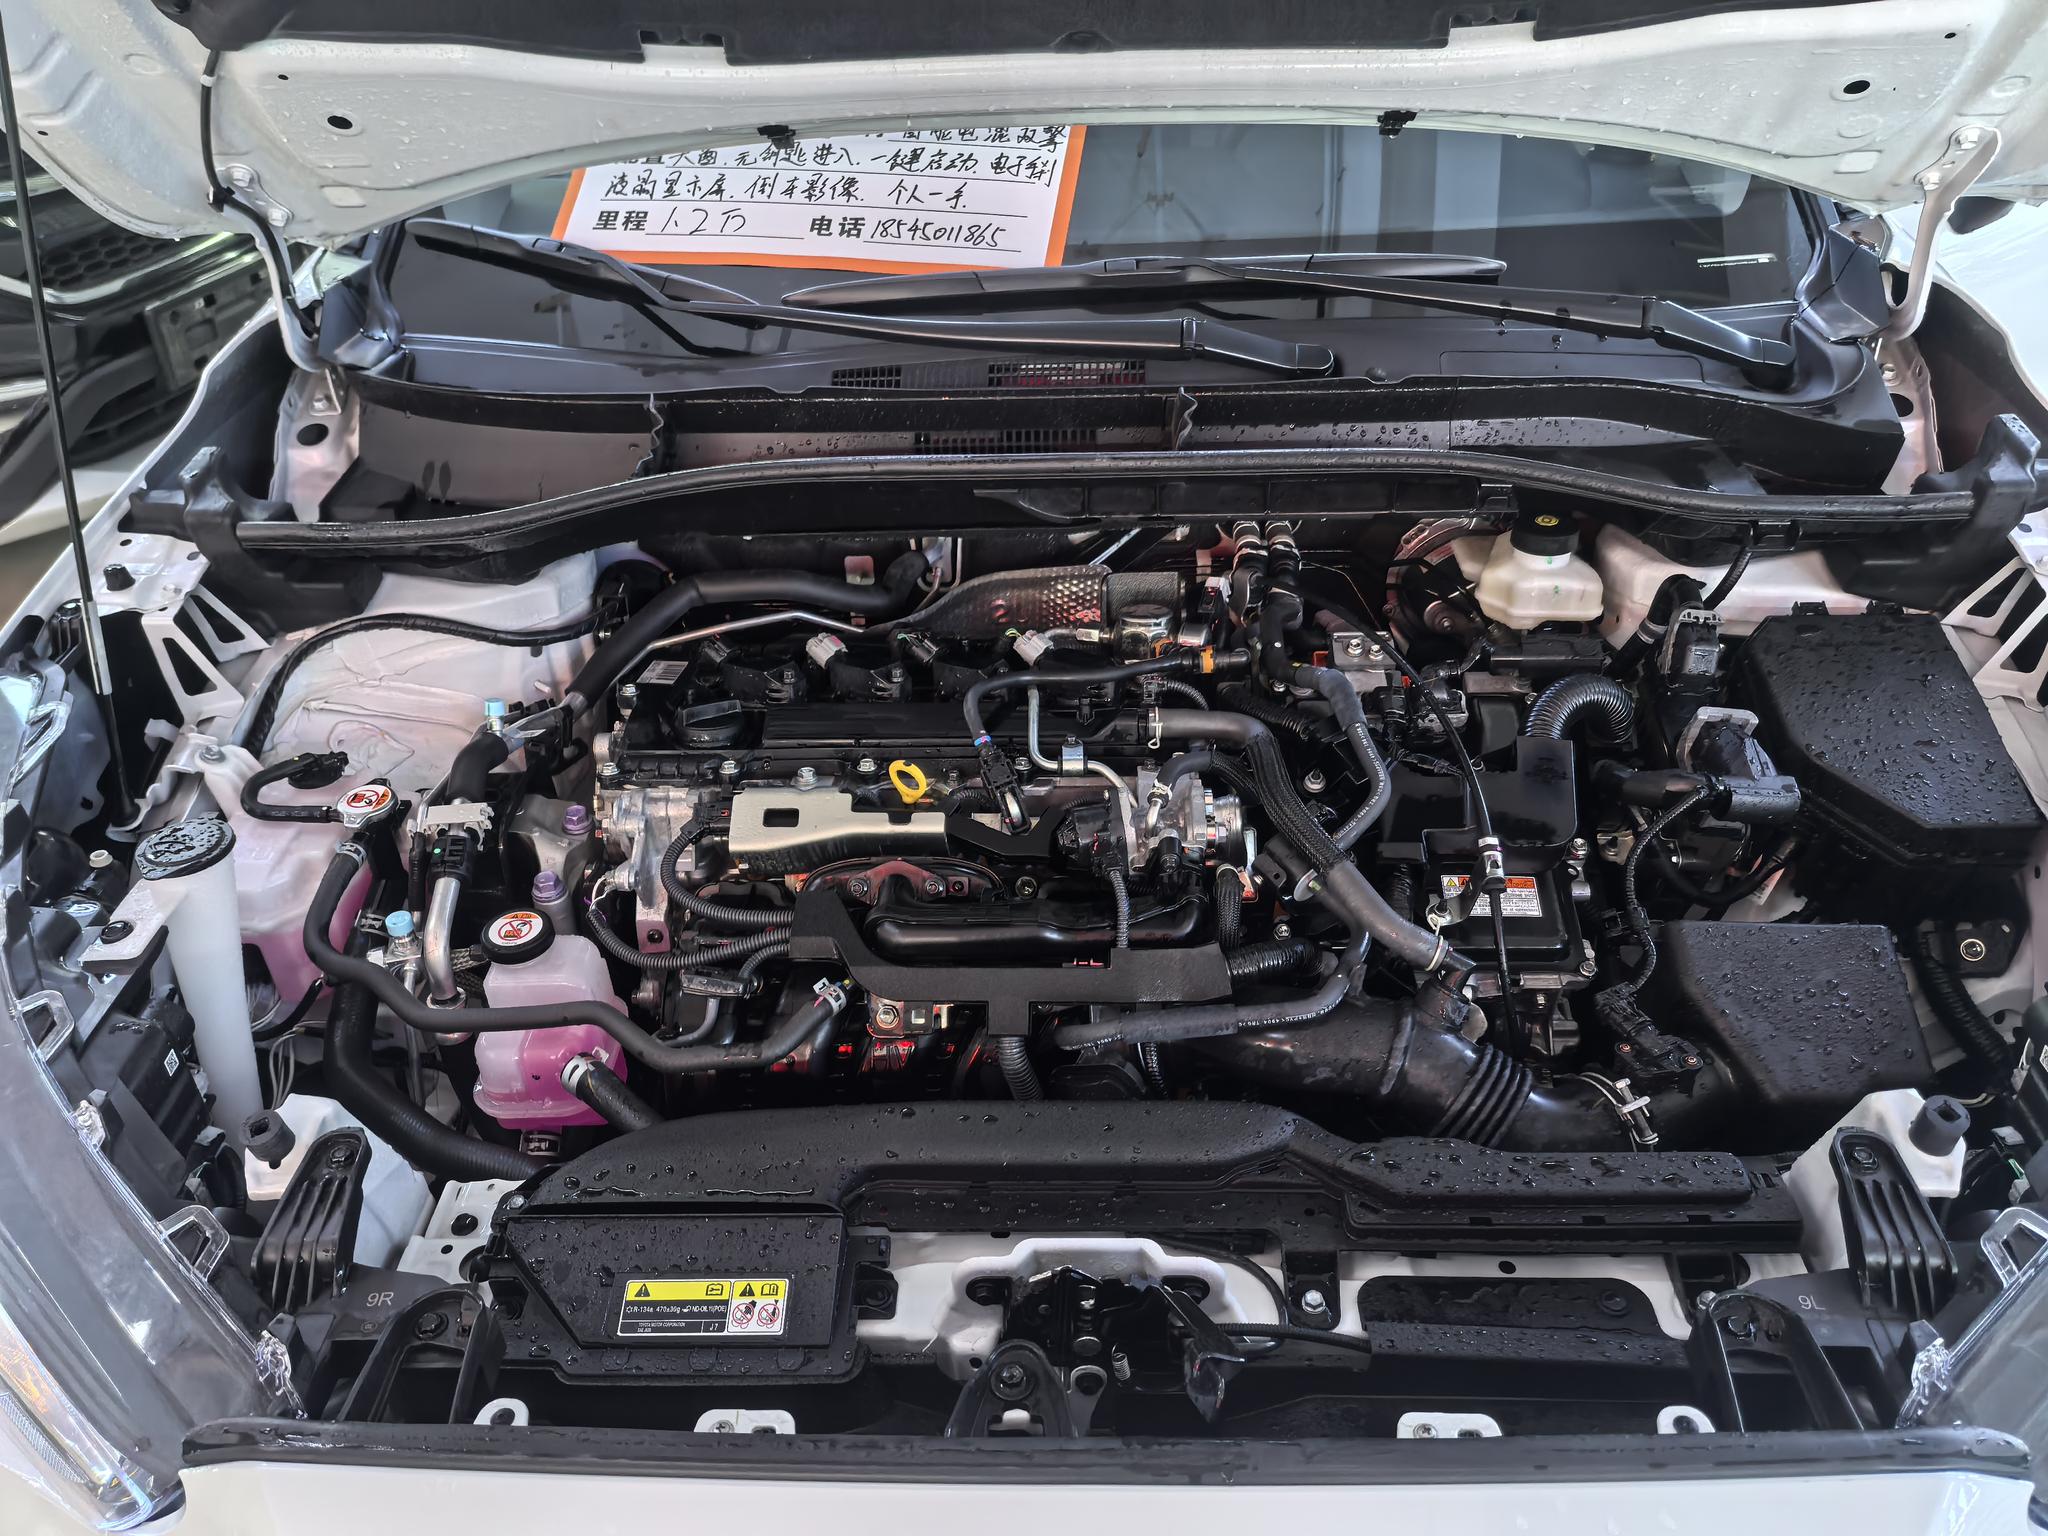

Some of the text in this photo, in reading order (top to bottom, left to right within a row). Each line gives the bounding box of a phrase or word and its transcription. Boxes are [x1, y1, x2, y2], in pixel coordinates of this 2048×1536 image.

[592, 210, 649, 232] 里程
[809, 215, 1007, 249] 电话 18545011865
[366, 1291, 394, 1307] 9R
[1798, 1295, 1826, 1310] 9L
